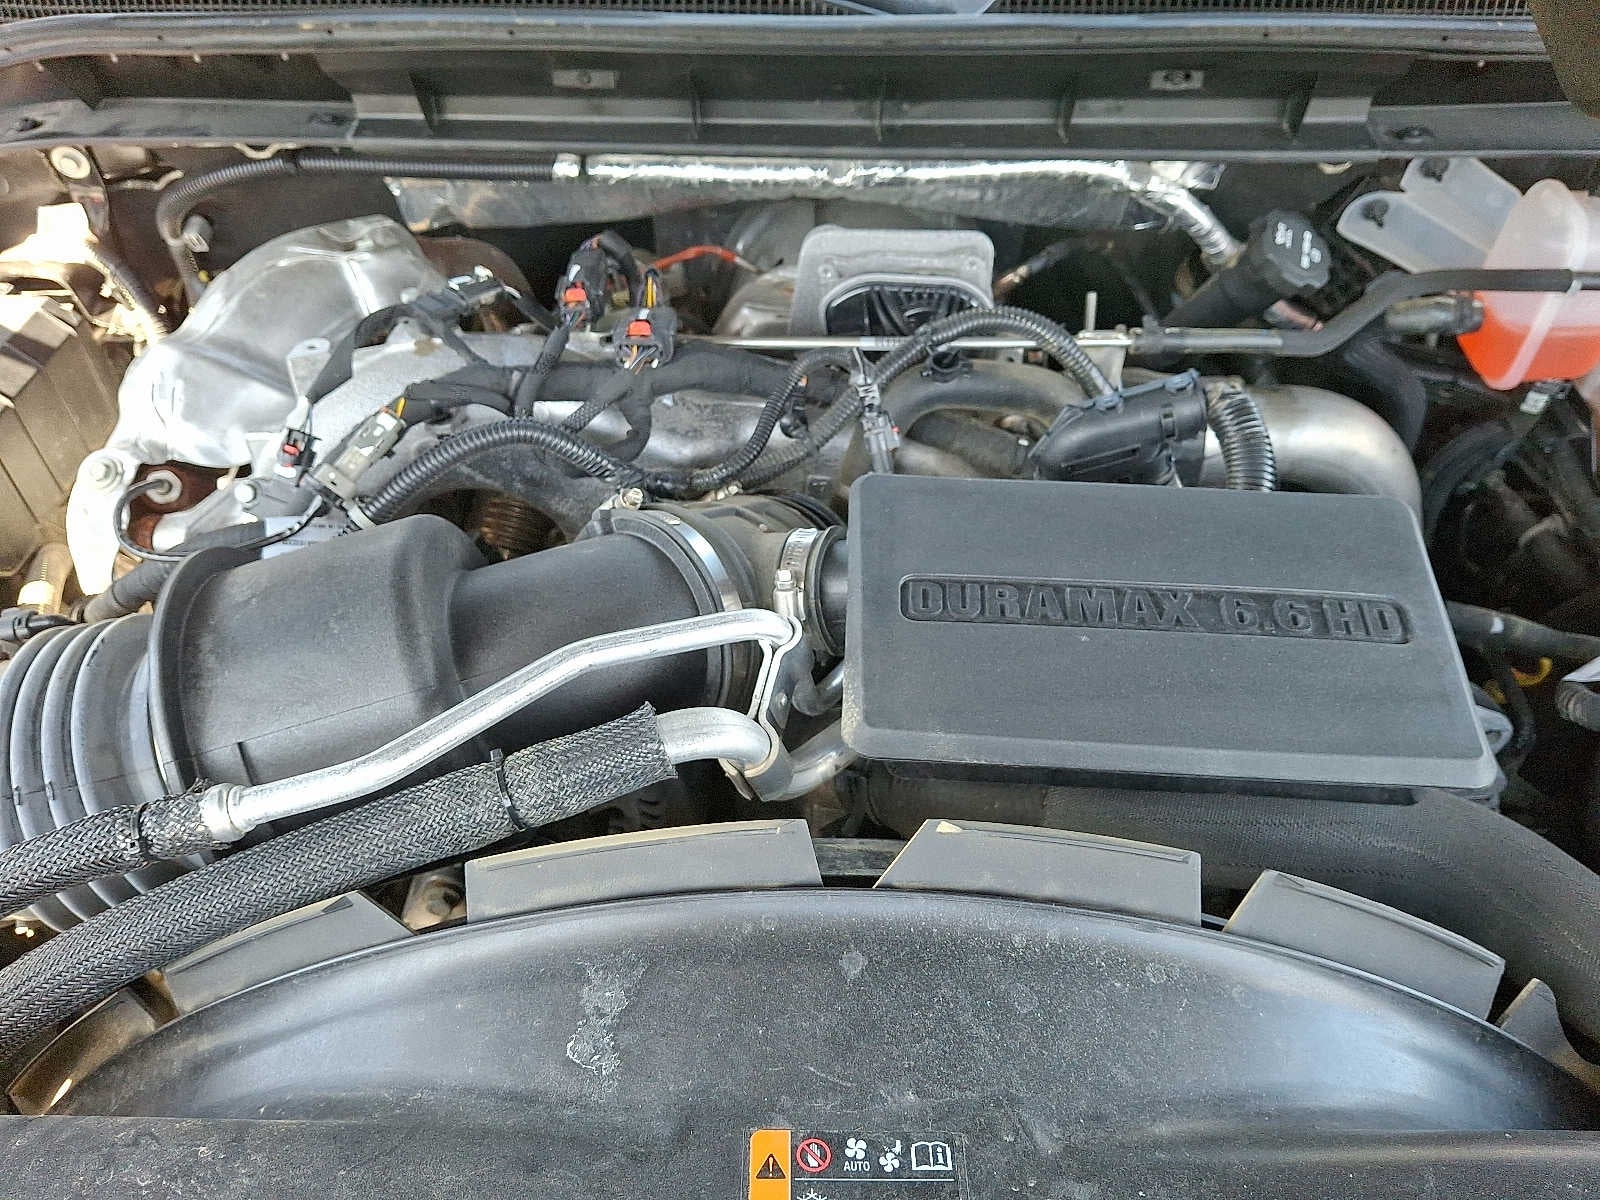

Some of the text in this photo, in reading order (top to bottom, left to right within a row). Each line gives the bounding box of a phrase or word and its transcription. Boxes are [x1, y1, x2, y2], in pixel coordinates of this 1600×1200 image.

[907, 580, 1405, 640] DURAMAX 6.6 HD
[843, 1160, 871, 1172] AUTO
